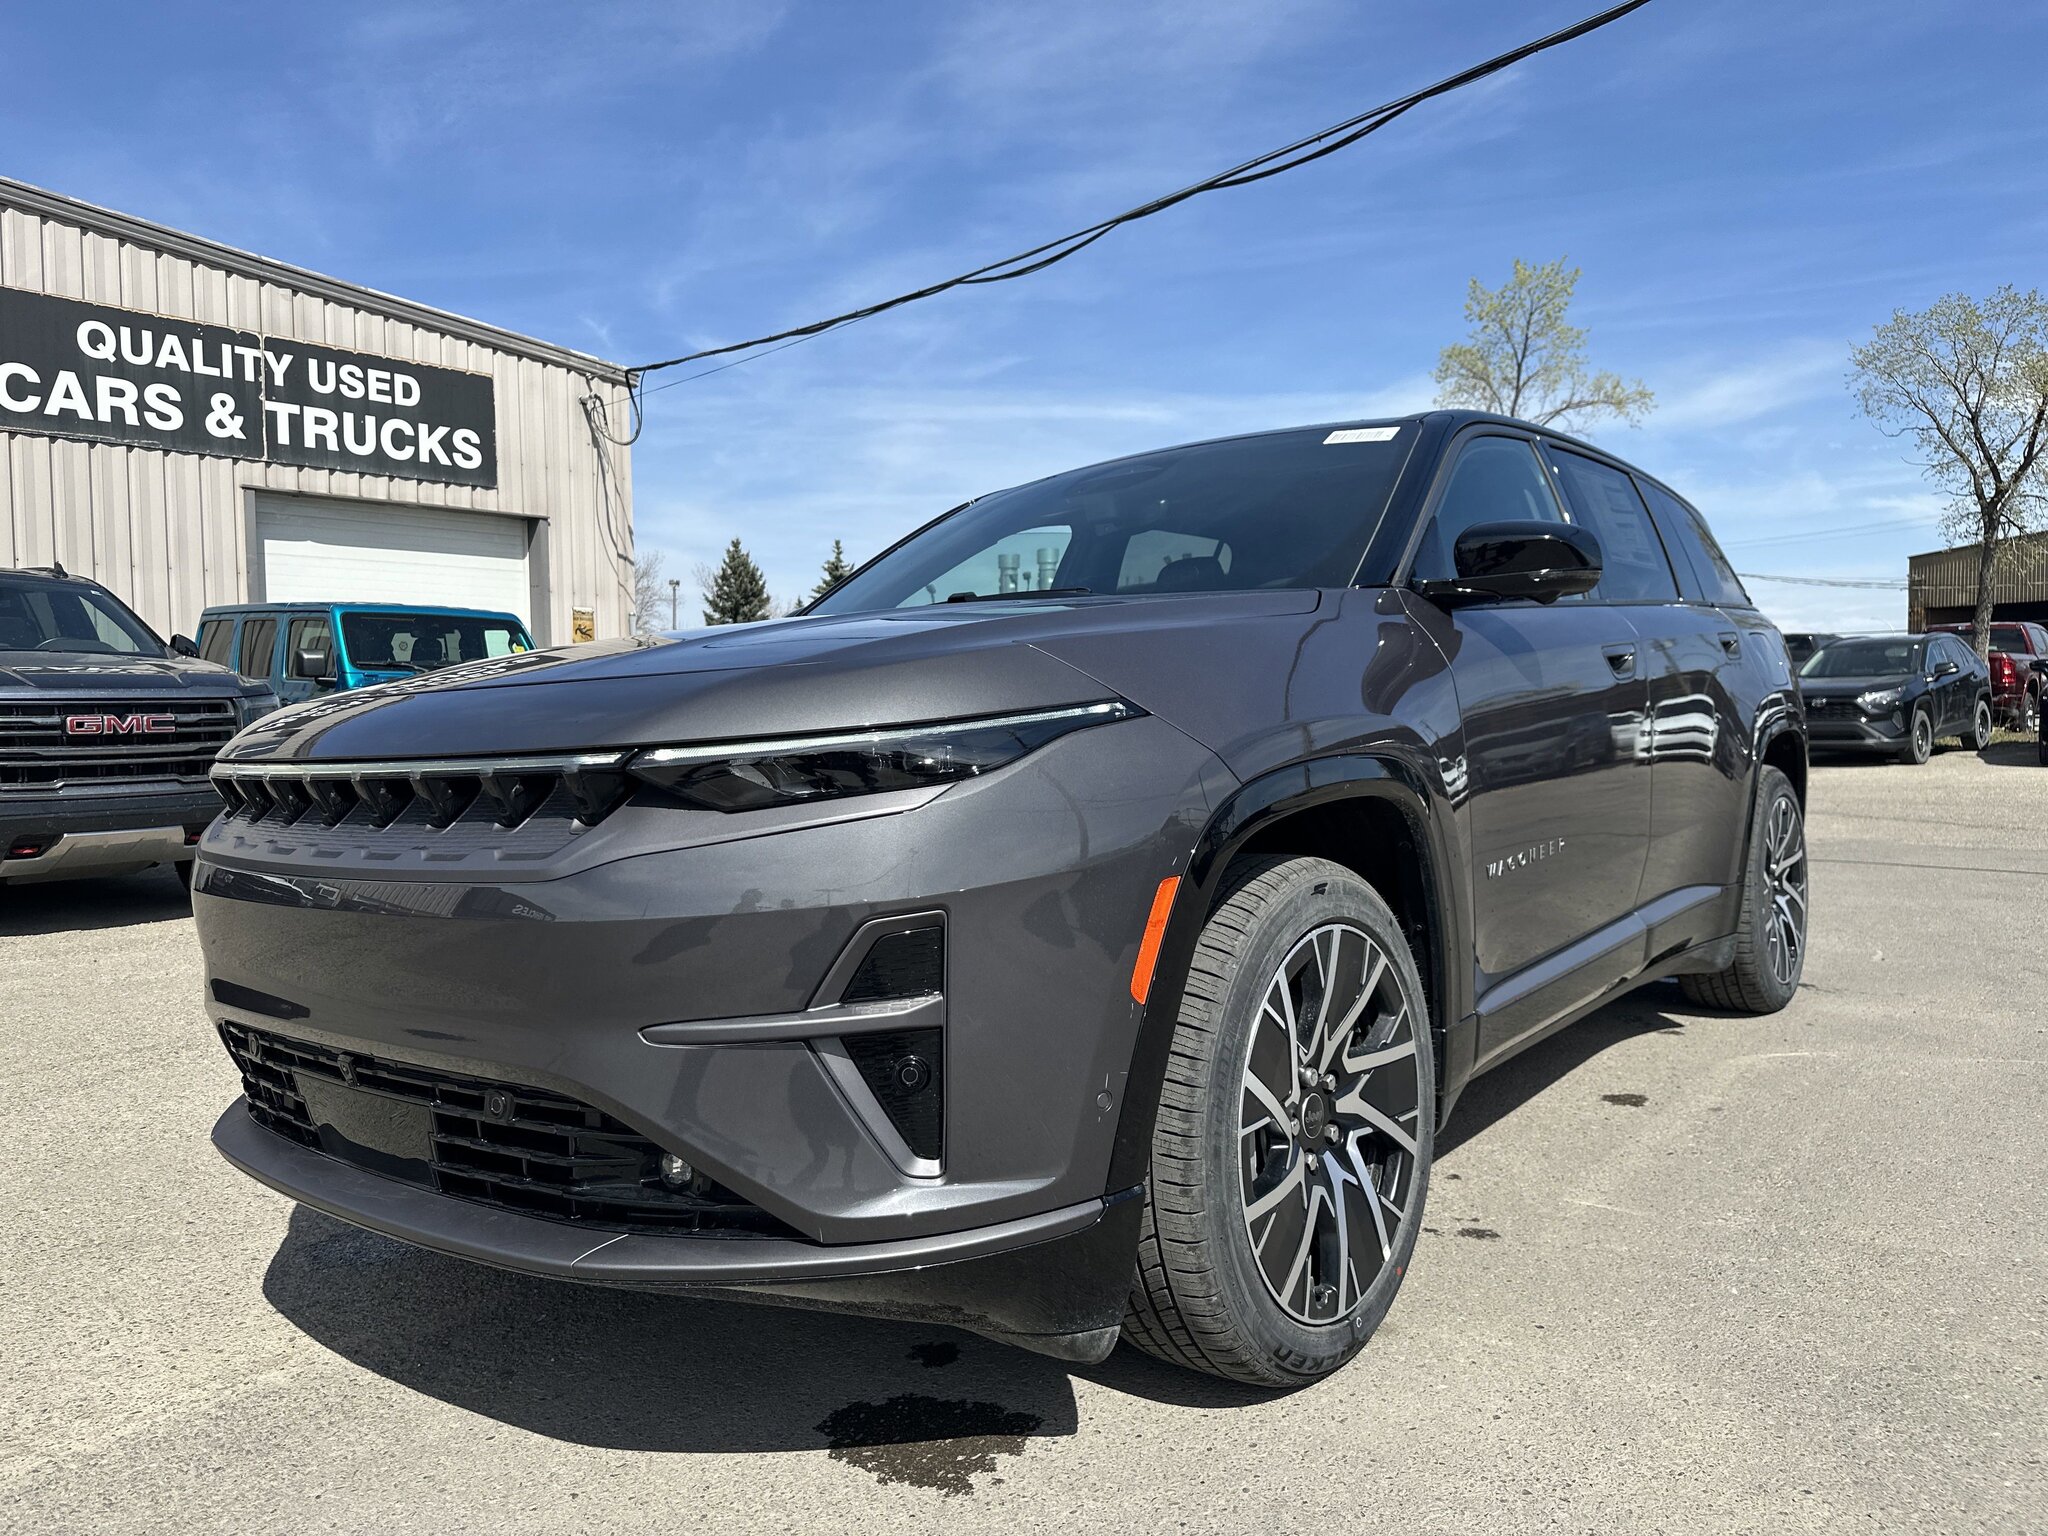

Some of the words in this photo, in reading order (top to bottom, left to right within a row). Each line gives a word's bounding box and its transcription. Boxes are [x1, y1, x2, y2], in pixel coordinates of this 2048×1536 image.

[76, 320, 293, 387] QUALITY
[308, 358, 421, 407] USED
[0, 362, 185, 431] CARS
[205, 392, 247, 440] &
[264, 401, 483, 470] TRUCKS
[66, 714, 175, 734] GMC
